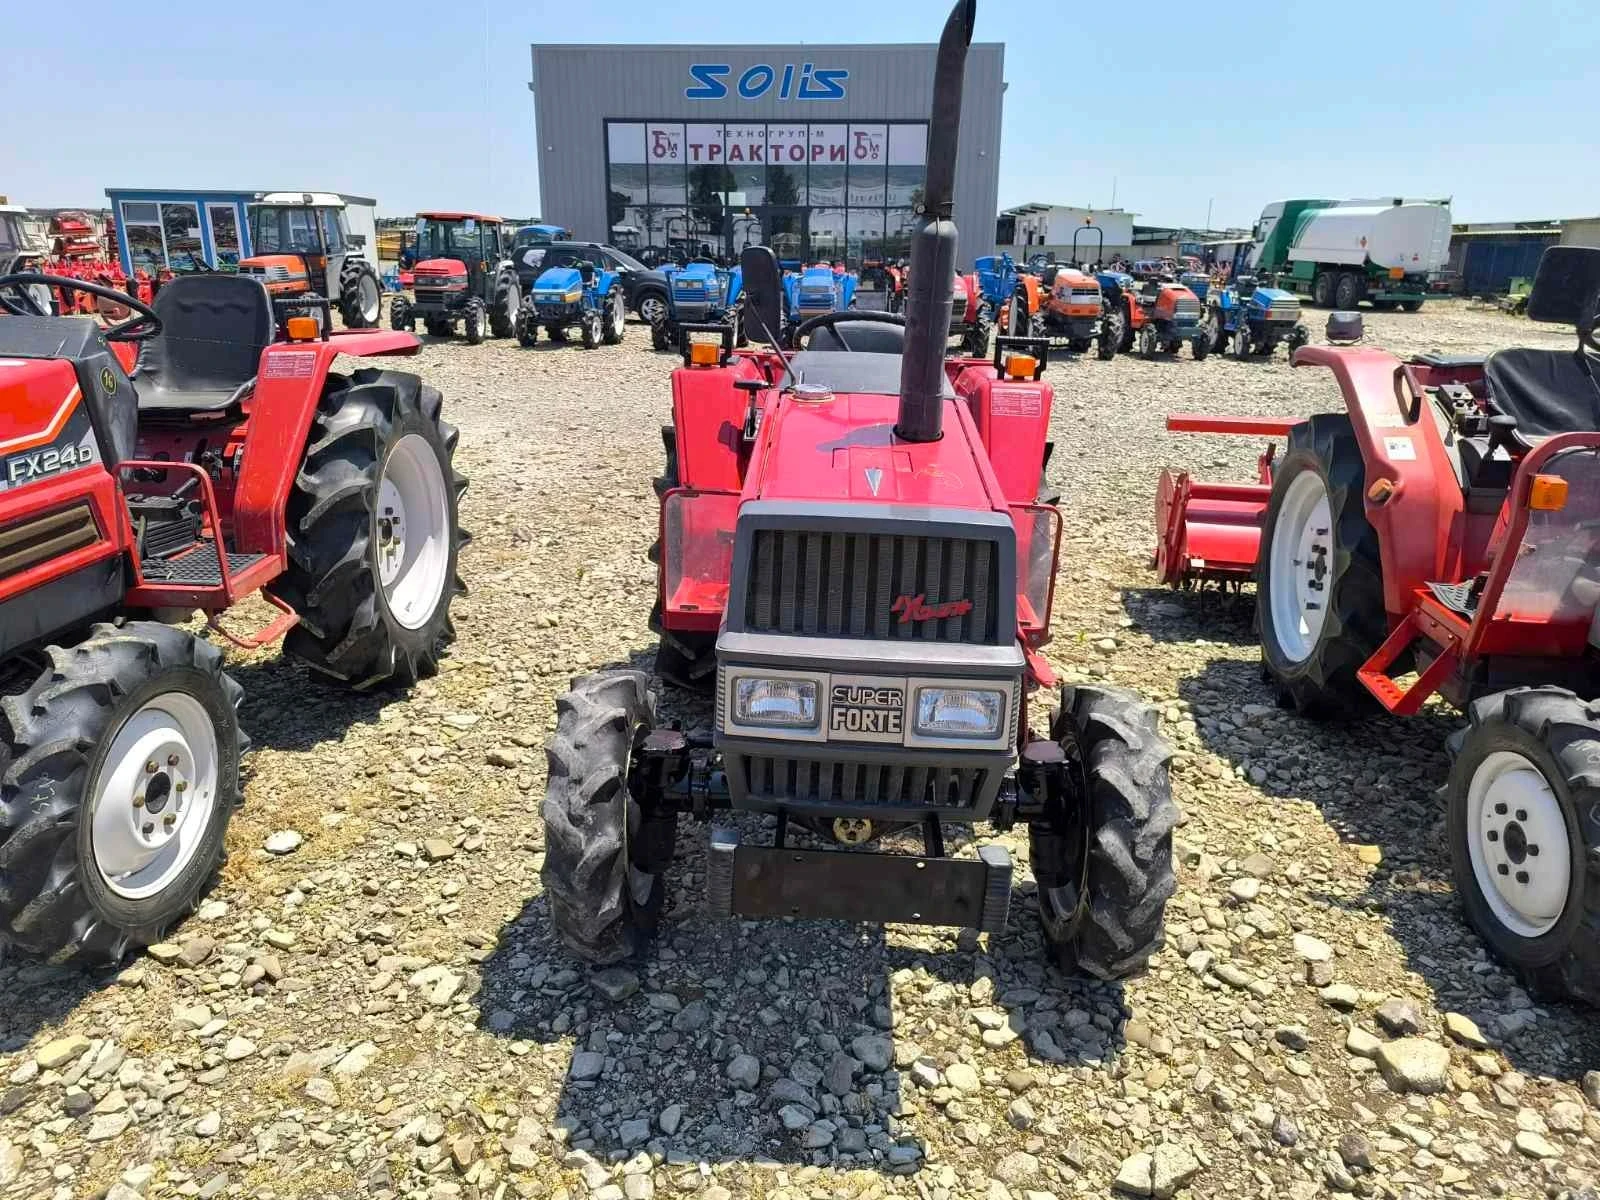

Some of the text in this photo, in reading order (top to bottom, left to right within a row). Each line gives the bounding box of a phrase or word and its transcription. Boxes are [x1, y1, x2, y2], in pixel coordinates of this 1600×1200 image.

[689, 143, 846, 162] ТРАКТОРИ
[8, 444, 92, 481] FX24D
[832, 686, 903, 706] SUPER
[832, 707, 902, 732] FORTE
